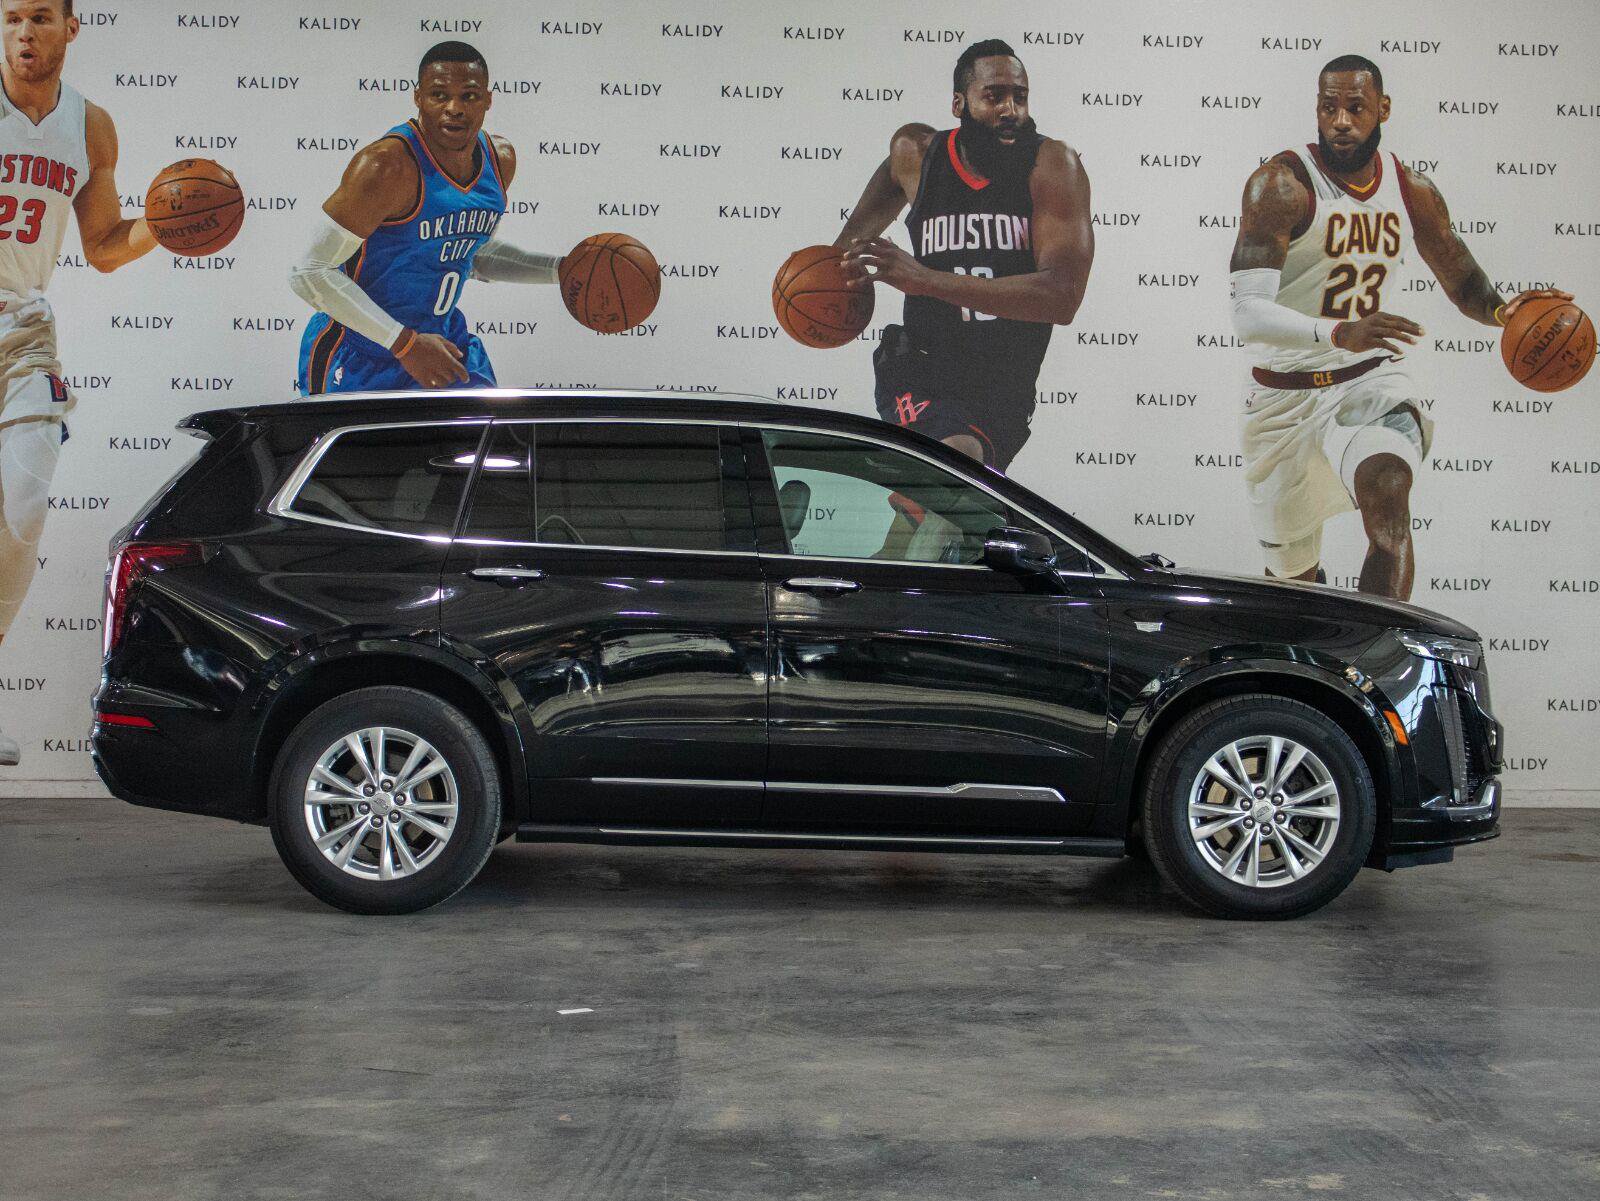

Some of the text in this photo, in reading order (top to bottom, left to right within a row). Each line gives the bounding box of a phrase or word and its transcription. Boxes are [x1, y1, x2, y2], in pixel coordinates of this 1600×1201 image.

[79, 13, 118, 26] LIDY
[177, 14, 240, 29] KALIDY
[299, 16, 361, 32] KALIDY
[420, 19, 483, 33] KALIDY
[541, 21, 603, 36] KALIDY
[661, 23, 724, 38] KALIDY
[783, 26, 845, 41] KALIDY
[903, 29, 966, 44] KALIDY
[1023, 31, 1085, 46] KALIDY
[1142, 34, 1204, 49] KALIDY
[1261, 37, 1323, 51] KALIDY
[1380, 40, 1441, 54] KALIDY
[1498, 43, 1560, 57] KALIDY
[115, 73, 178, 88] KALIDY
[237, 75, 300, 90] KALIDY
[491, 81, 542, 94] ALIDY
[600, 82, 662, 97] KALIDY
[720, 84, 784, 99] KALIDY
[842, 87, 904, 102] KALIDY
[1082, 92, 1143, 107] KALIDY
[1201, 95, 1262, 110] KALIDY
[1438, 100, 1500, 115] KALIDY
[1556, 103, 1600, 118] KALI
[175, 135, 238, 149] KALIDY
[297, 137, 359, 151] KALIDY
[539, 141, 601, 156] KALIDY
[659, 143, 722, 158] KALIDY
[781, 146, 843, 161] KALIDY
[1140, 153, 1202, 168] KALIDY
[0, 153, 78, 198] STONS
[1496, 161, 1557, 176] KALIDY
[246, 197, 296, 211] ALIDY
[598, 203, 660, 217] KALIDY
[0, 195, 46, 244] 23
[718, 205, 782, 220] KALIDY
[1091, 212, 1141, 228] ALIDY
[419, 208, 500, 241] OKLAHOM
[1199, 215, 1243, 229] KALI
[1449, 220, 1497, 234] ALIDY
[921, 213, 1030, 257] HOUSTON
[1324, 212, 1401, 259] CAVS
[440, 238, 477, 263] CITY
[173, 256, 236, 270] KALIDY
[1138, 273, 1200, 287] KALIDY
[1319, 262, 1388, 320] 23
[111, 315, 174, 330] KALIDY
[233, 317, 296, 332] KALIDY
[475, 321, 538, 335] KALIDY
[716, 325, 779, 339] KALIDY
[1077, 332, 1139, 346] KALIDY
[1433, 340, 1495, 354] KALIDY
[63, 375, 112, 389] ALIDY
[171, 376, 234, 391] KALIDY
[1312, 371, 1334, 387] CLE
[776, 387, 839, 401] KALIDY
[1036, 391, 1078, 405] LIDY
[1136, 393, 1198, 407] KALIDY
[1492, 400, 1554, 414] KALIDY
[109, 436, 172, 451] KALIDY
[1075, 451, 1137, 466] KALIDY
[1431, 458, 1494, 472] KALIDY
[1550, 460, 1600, 474] KALID
[47, 496, 110, 510] KALIDY
[808, 507, 836, 521] IDY
[1134, 512, 1195, 527] KALIDY
[1490, 519, 1552, 533] KALIDY
[1430, 577, 1492, 592] KALIDY
[1549, 579, 1600, 593] KALID
[1488, 638, 1550, 652] KALIDY
[0, 677, 47, 691] ALIDY
[1547, 698, 1600, 712] KALID
[1502, 758, 1548, 770] ALIDY
